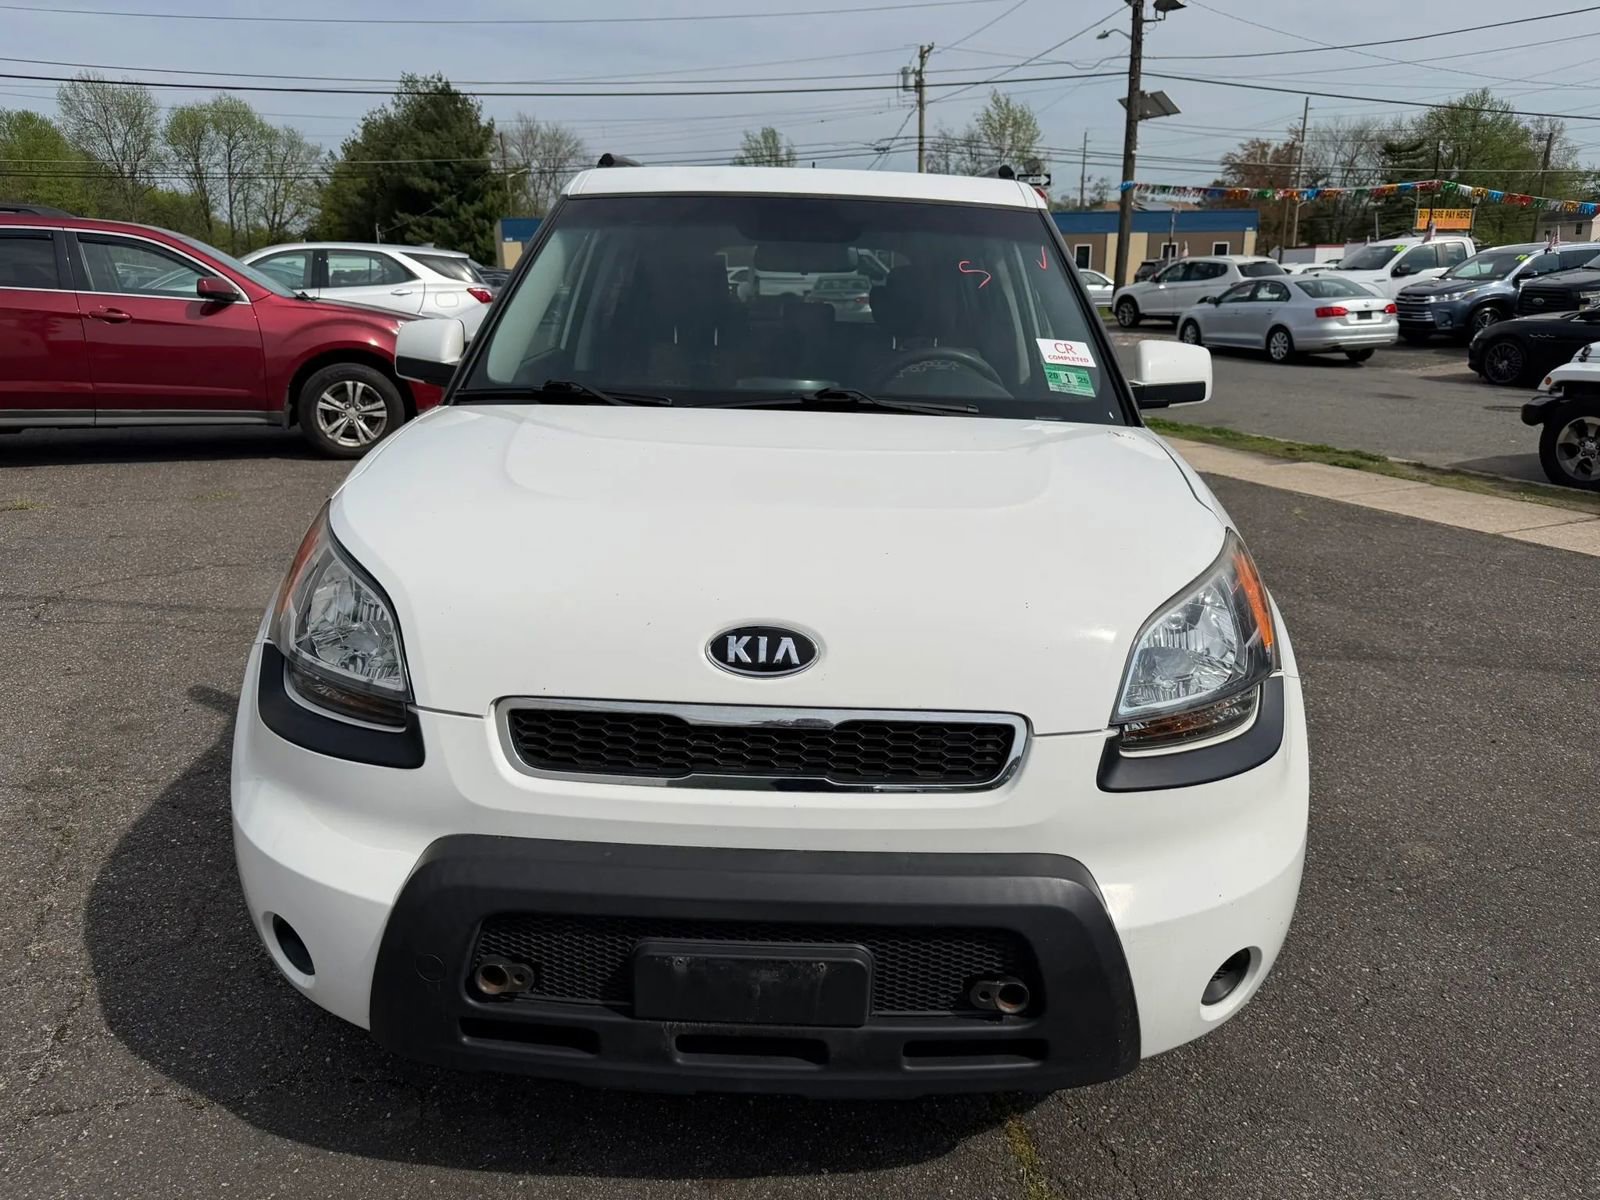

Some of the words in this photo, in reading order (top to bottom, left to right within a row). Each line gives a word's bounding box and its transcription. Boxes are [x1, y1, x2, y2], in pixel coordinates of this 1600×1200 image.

[1444, 210, 1456, 219] PAY
[1456, 210, 1471, 219] HERE
[1054, 342, 1077, 355] CR
[1048, 354, 1090, 363] COMPLETED
[1064, 373, 1072, 384] 1
[726, 635, 801, 665] KIA
